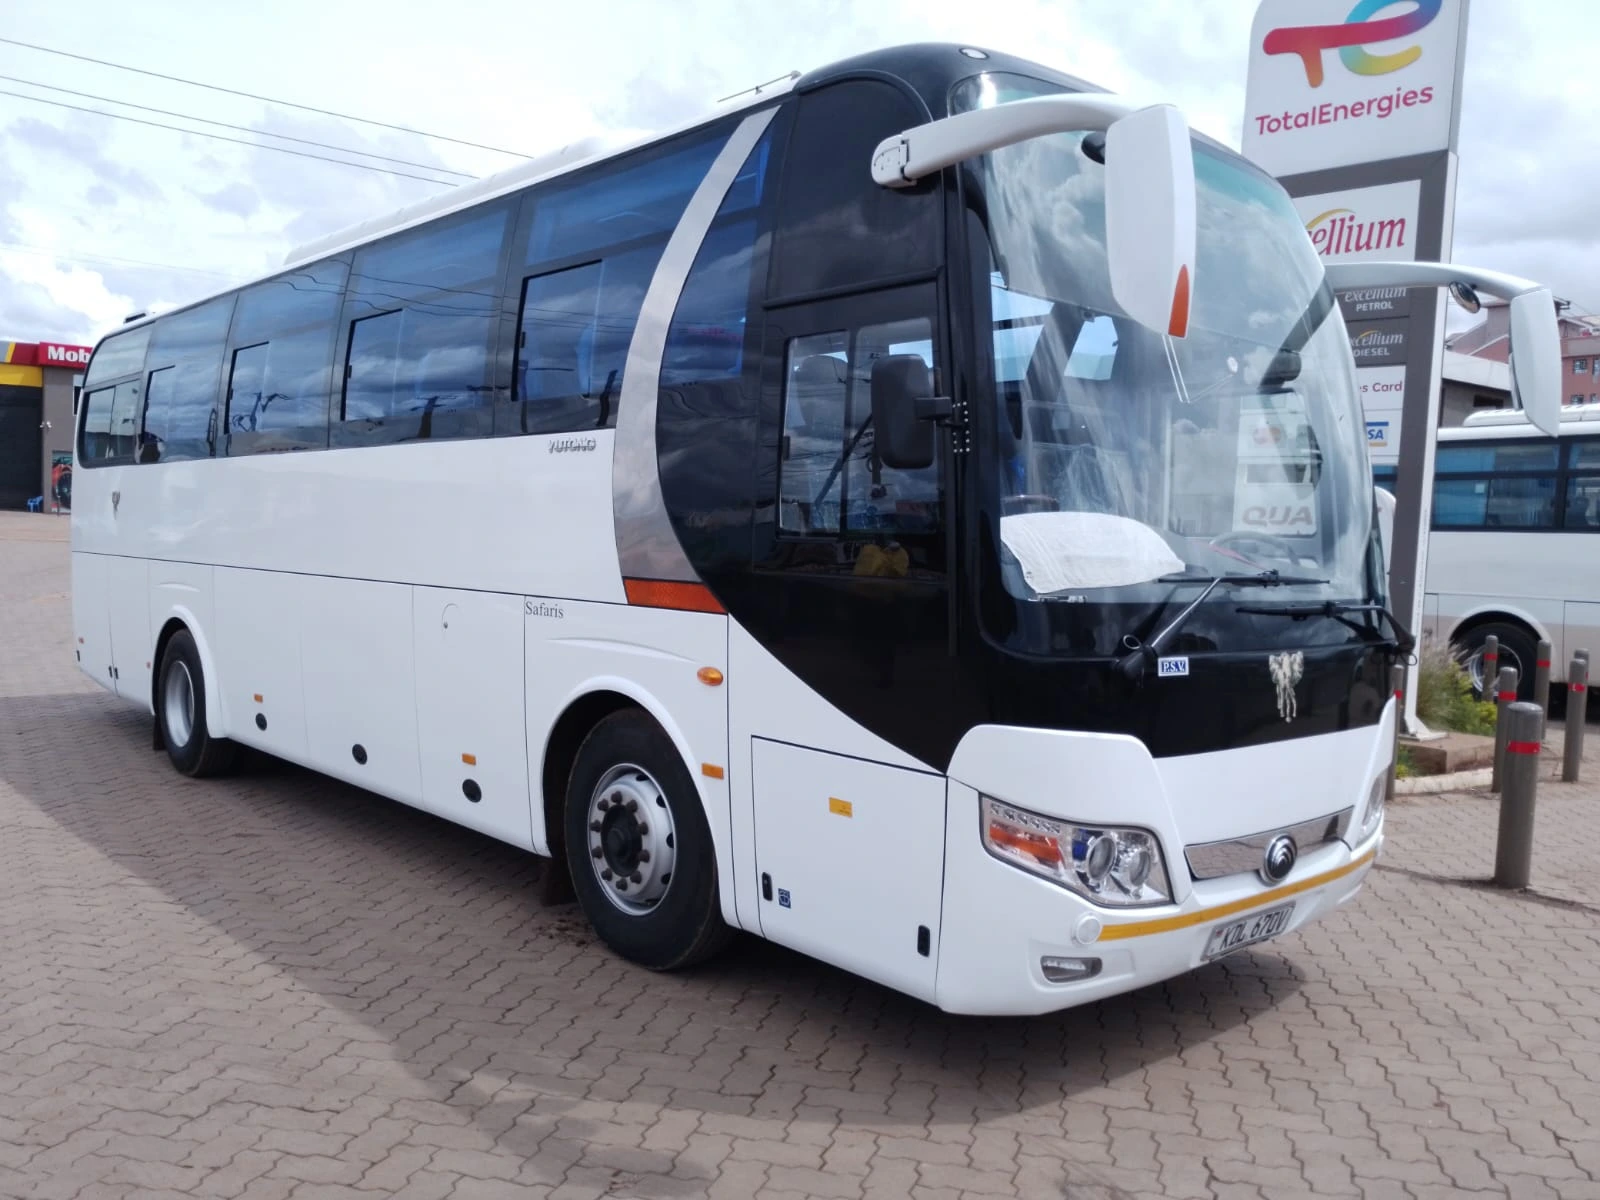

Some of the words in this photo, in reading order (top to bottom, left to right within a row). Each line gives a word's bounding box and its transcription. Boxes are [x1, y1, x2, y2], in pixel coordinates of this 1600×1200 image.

[1255, 86, 1434, 135] TotalEnergies
[1308, 214, 1406, 255] ellium
[1356, 301, 1393, 312] PETROL
[1353, 347, 1390, 358] DIESEL
[1372, 380, 1402, 392] Card
[525, 600, 564, 619] Safaris
[1219, 921, 1248, 950] KDL
